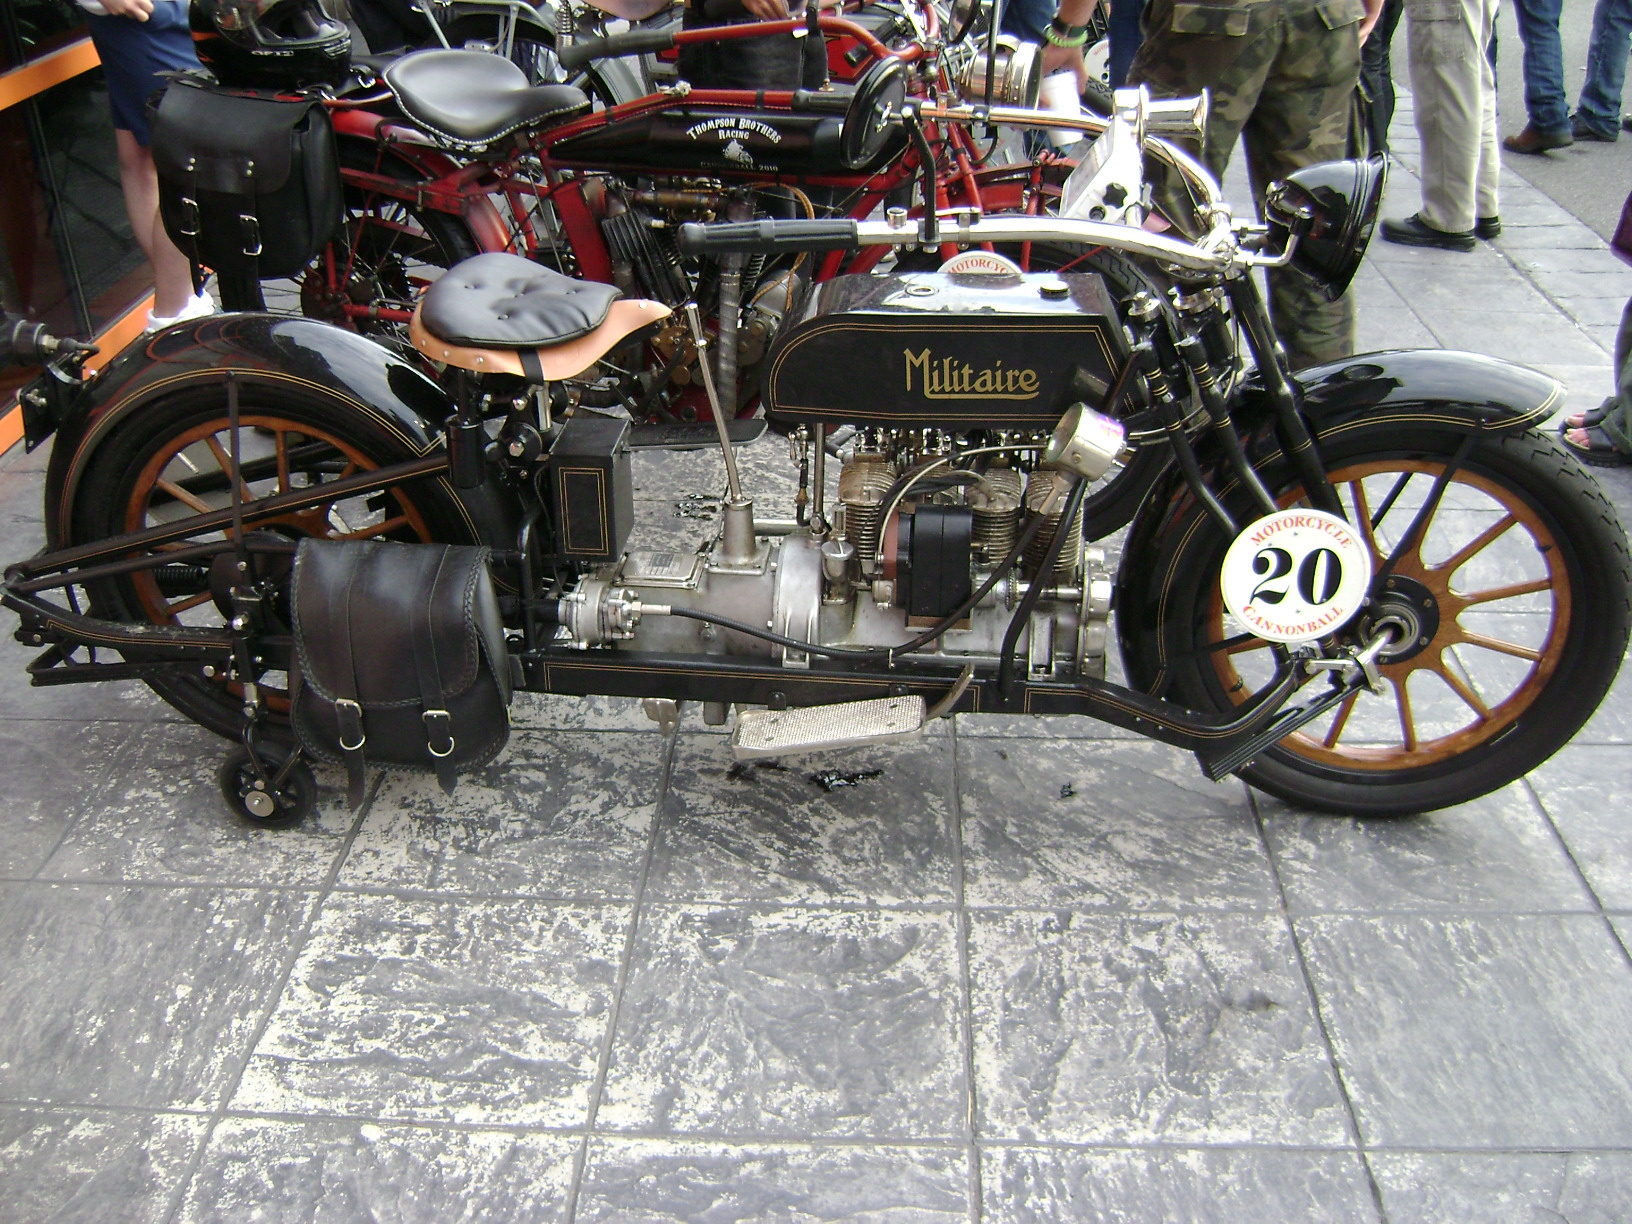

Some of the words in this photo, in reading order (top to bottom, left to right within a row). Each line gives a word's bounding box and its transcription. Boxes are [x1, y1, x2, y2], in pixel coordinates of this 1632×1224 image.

[686, 118, 736, 140] THOMPSON
[738, 118, 782, 144] BROTHERS
[718, 129, 750, 140] RACING
[758, 164, 779, 172] 2010
[903, 348, 1040, 400] Militaire
[1250, 516, 1353, 549] MOTORCYCLE
[1249, 547, 1343, 606] 20
[1242, 604, 1345, 636] CANNONBALL
